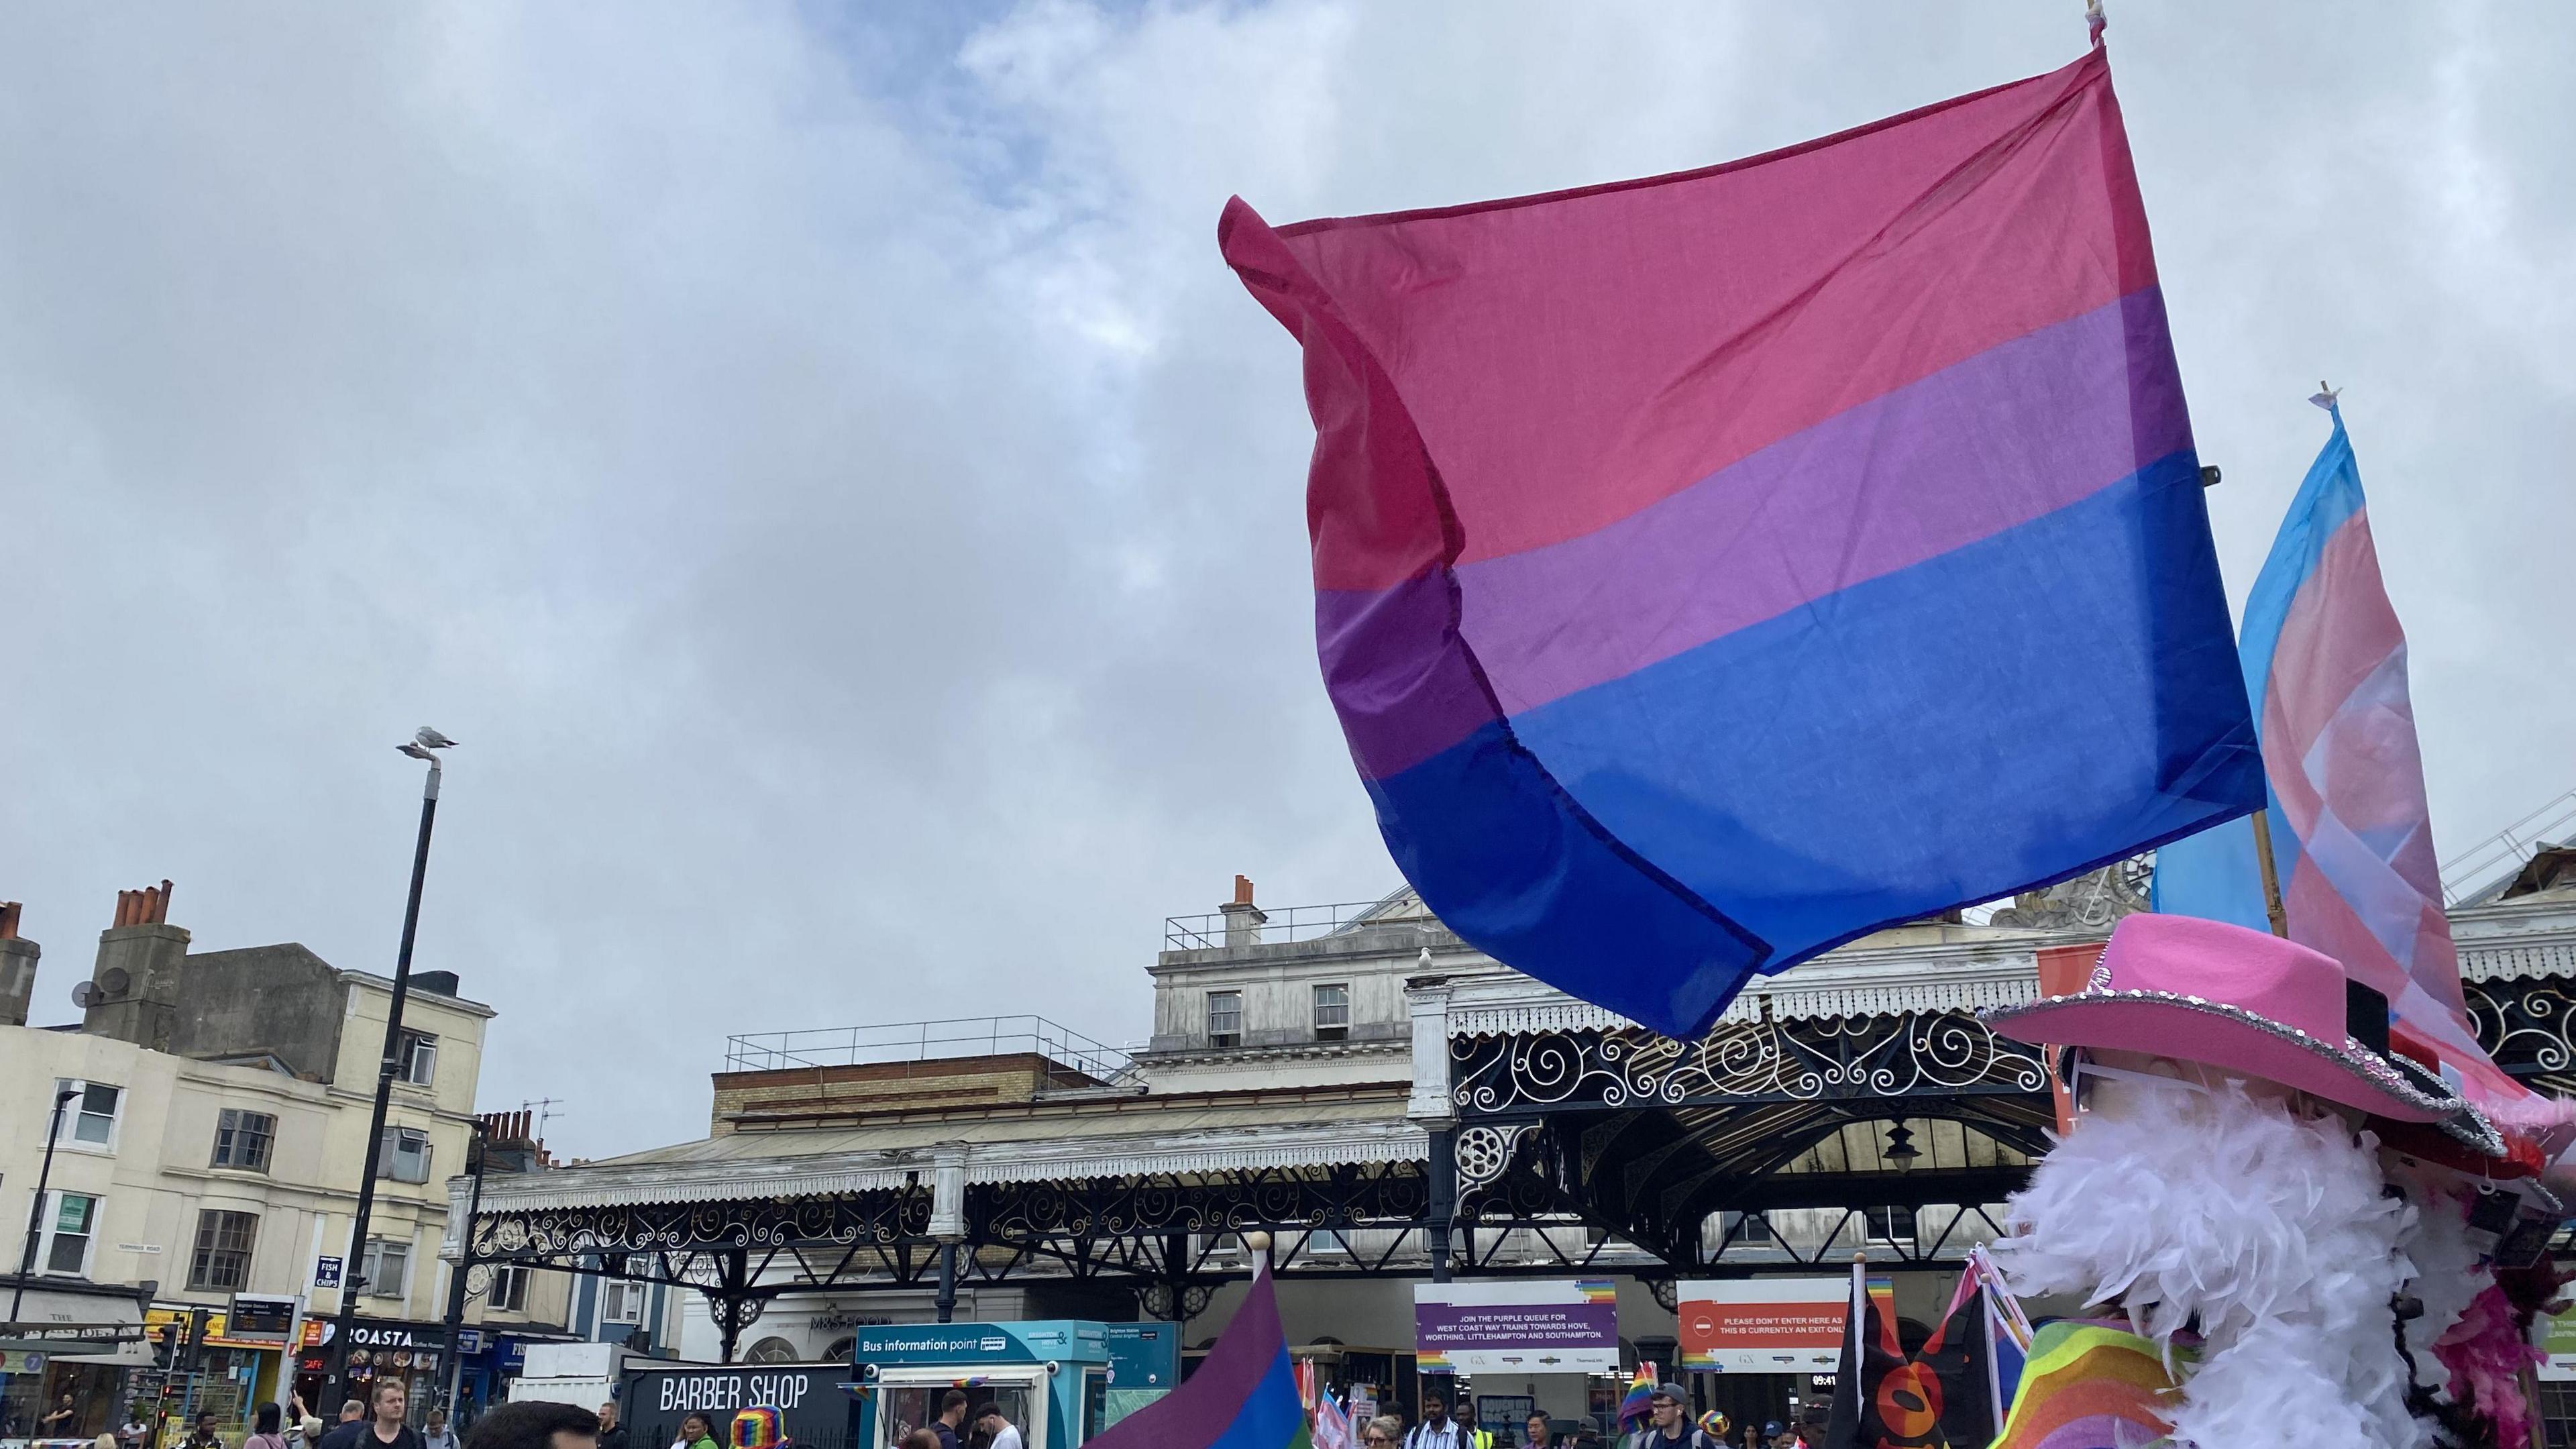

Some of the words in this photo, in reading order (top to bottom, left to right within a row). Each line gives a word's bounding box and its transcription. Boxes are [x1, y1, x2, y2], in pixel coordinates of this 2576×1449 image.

[321, 1263, 338, 1272] FISH
[325, 1271, 331, 1279] &
[316, 1279, 338, 1287] CHIPS
[50, 1313, 73, 1322] THE
[810, 1316, 841, 1330] M&S
[846, 1316, 891, 1329] FOOD
[863, 1341, 881, 1352] Bus
[885, 1338, 947, 1352] information
[950, 1338, 977, 1352] point
[30, 1357, 39, 1368] 7
[1813, 1375, 1836, 1385] 09:41
[660, 1377, 741, 1410] BARBER
[749, 1375, 808, 1408] SHOP
